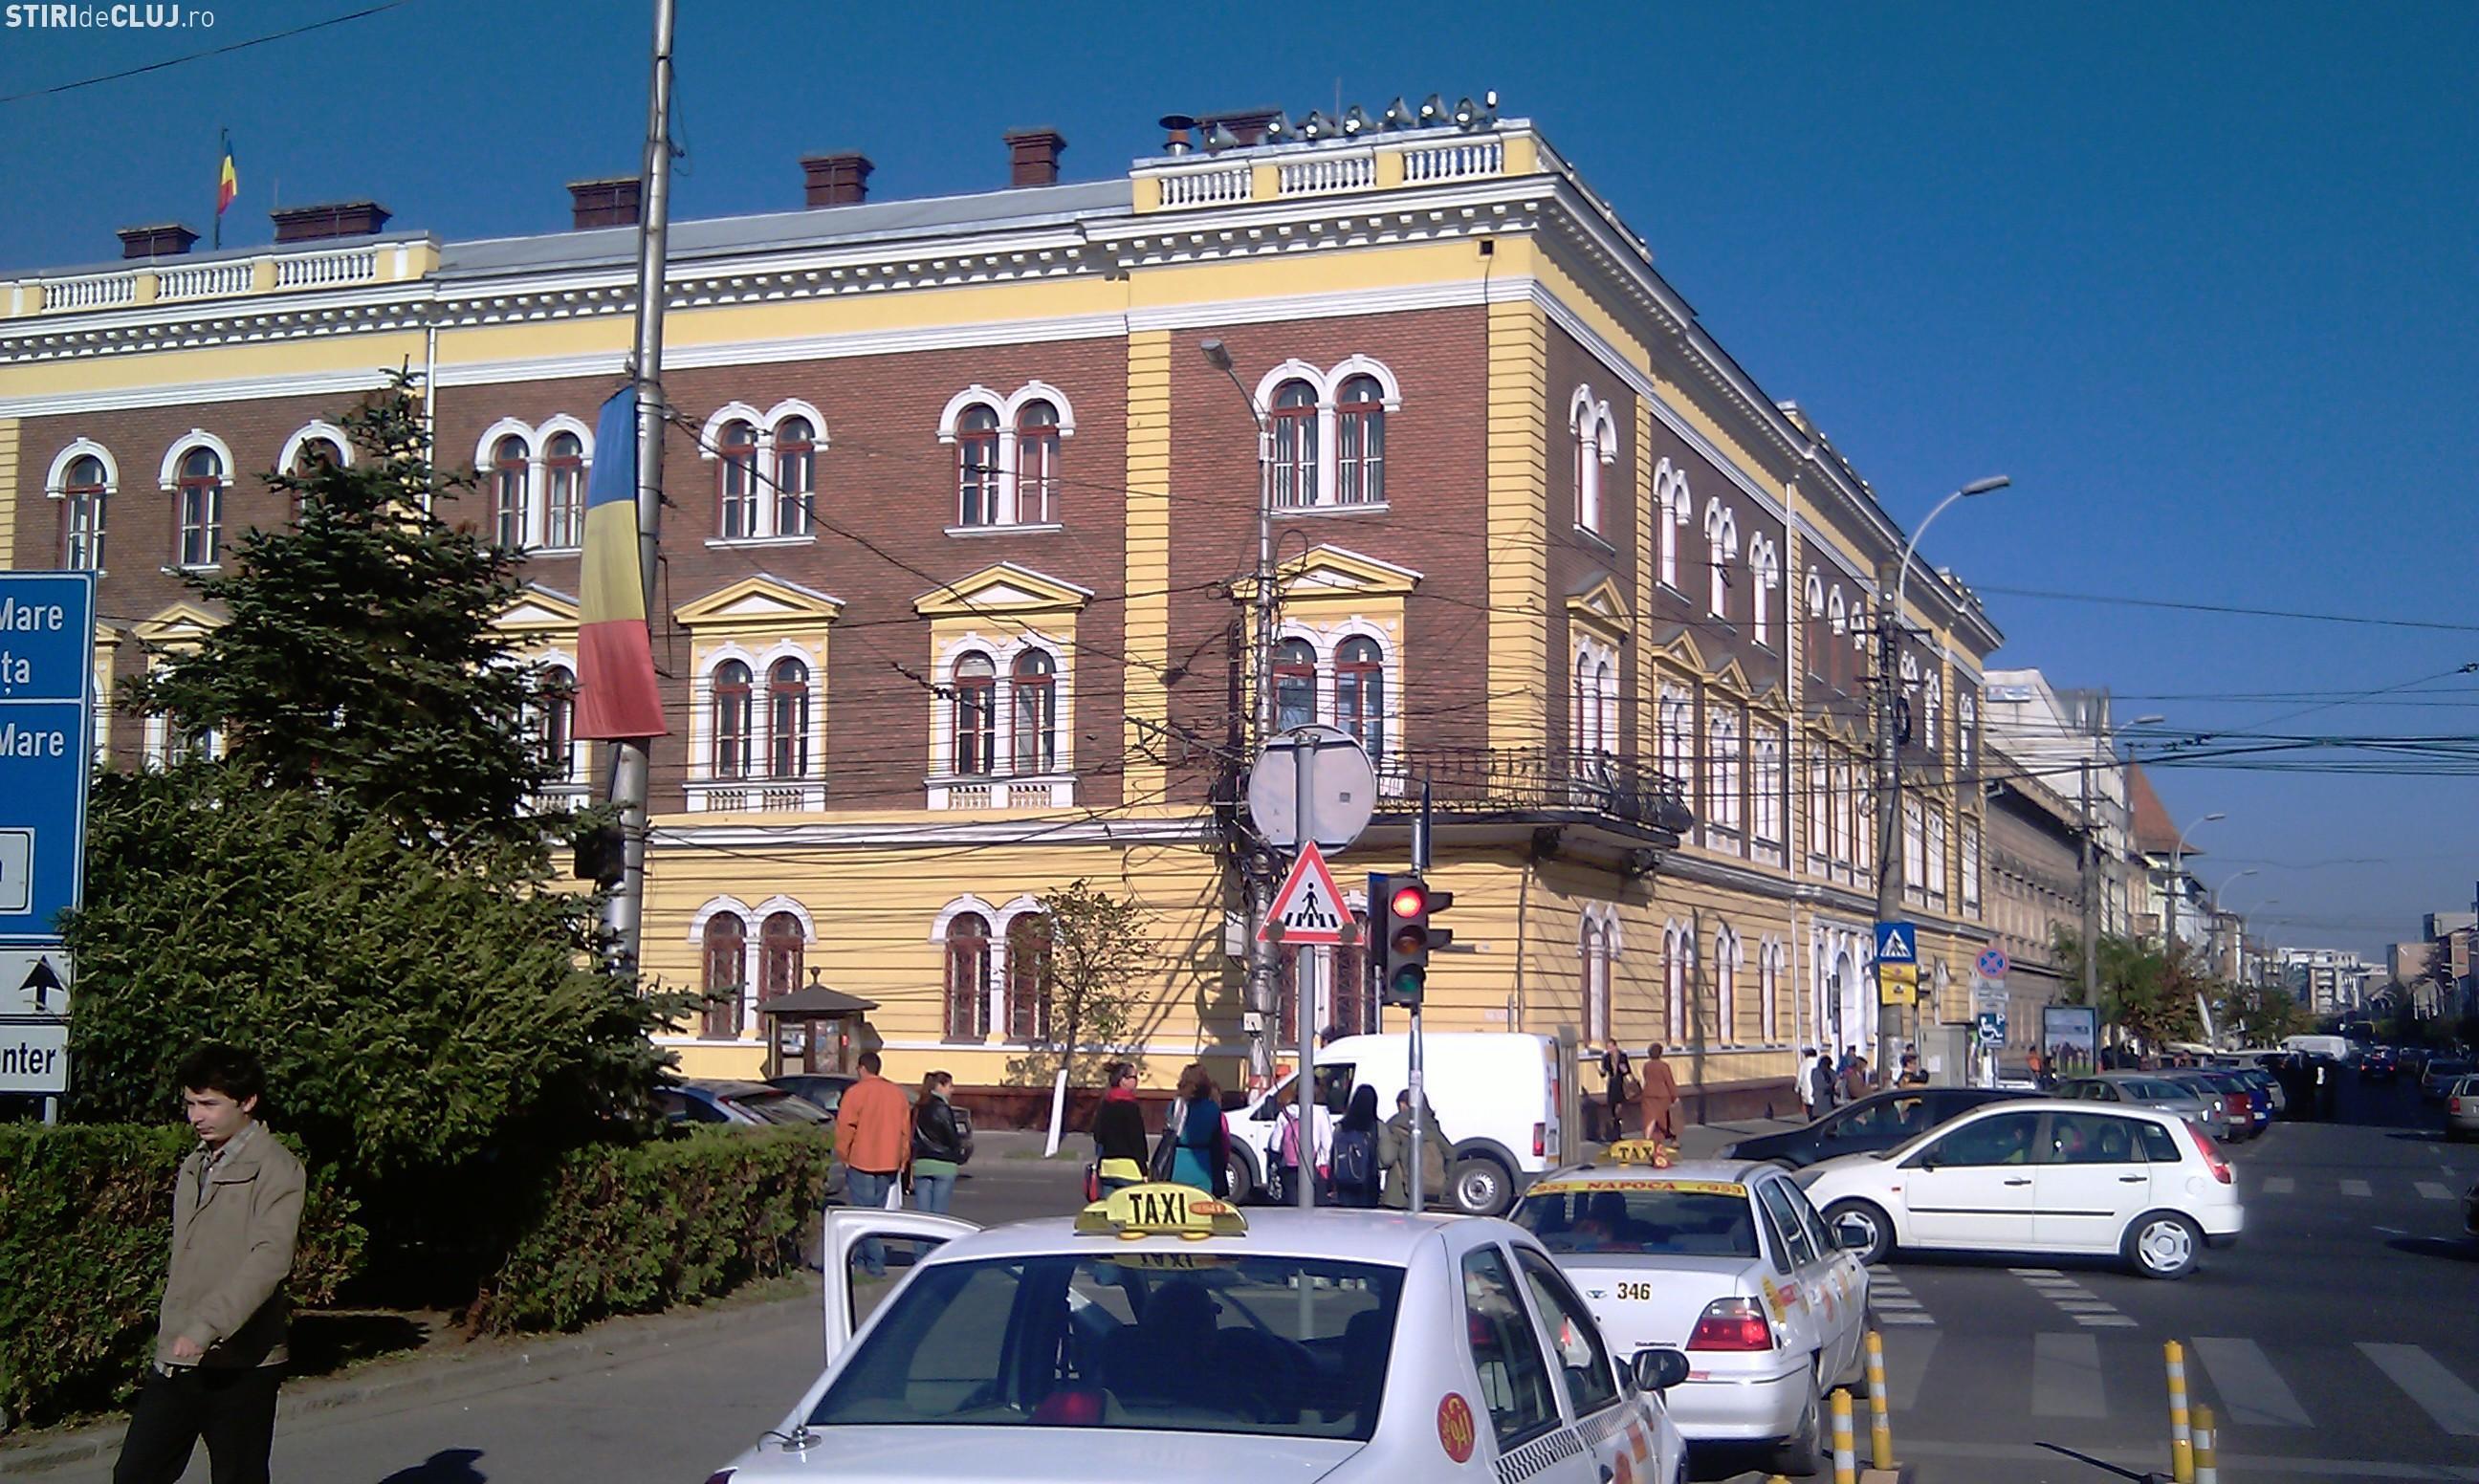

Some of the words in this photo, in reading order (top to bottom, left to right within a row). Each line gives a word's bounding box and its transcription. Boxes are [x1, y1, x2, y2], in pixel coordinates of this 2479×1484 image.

[2, 1041, 57, 1075] nter
[1587, 1181, 1677, 1191] NAPOCA
[1129, 1192, 1187, 1225] TAXI
[1616, 1282, 1651, 1300] 346
